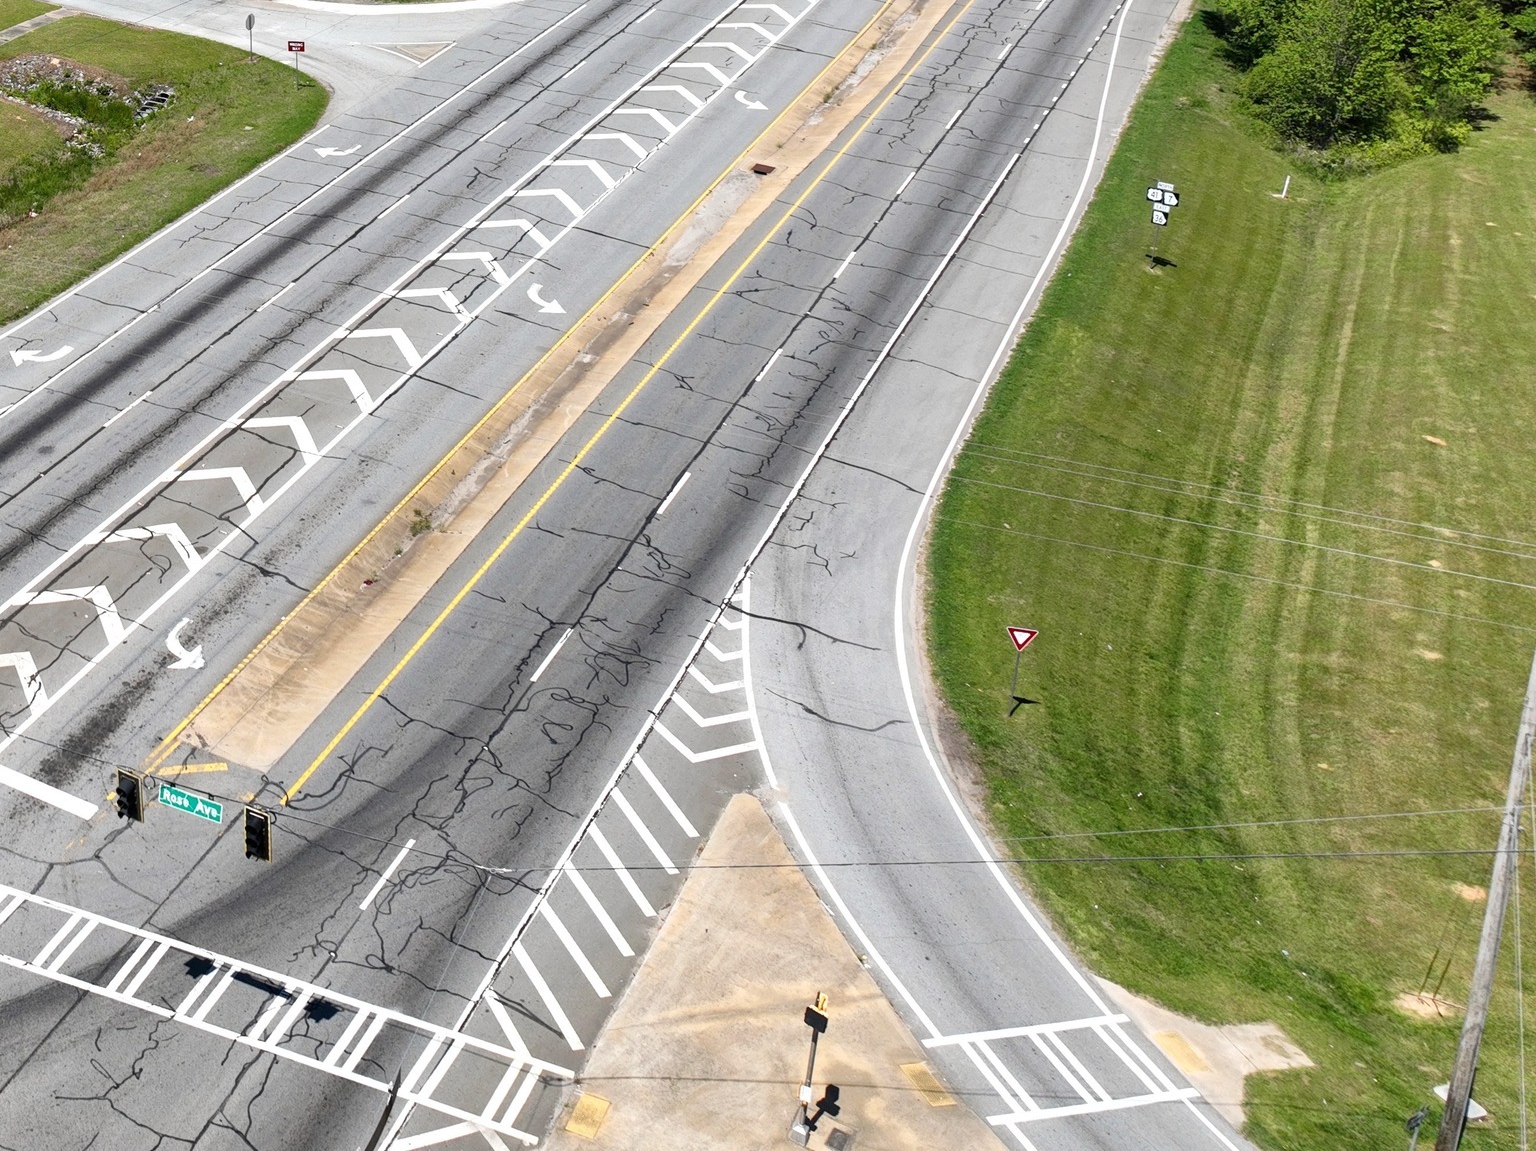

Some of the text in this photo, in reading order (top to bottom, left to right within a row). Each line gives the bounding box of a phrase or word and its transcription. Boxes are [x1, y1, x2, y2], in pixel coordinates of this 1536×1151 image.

[1151, 191, 1159, 199] 41
[1168, 195, 1173, 203] 7
[1155, 214, 1164, 223] 36
[163, 788, 218, 818] Rose Ave
